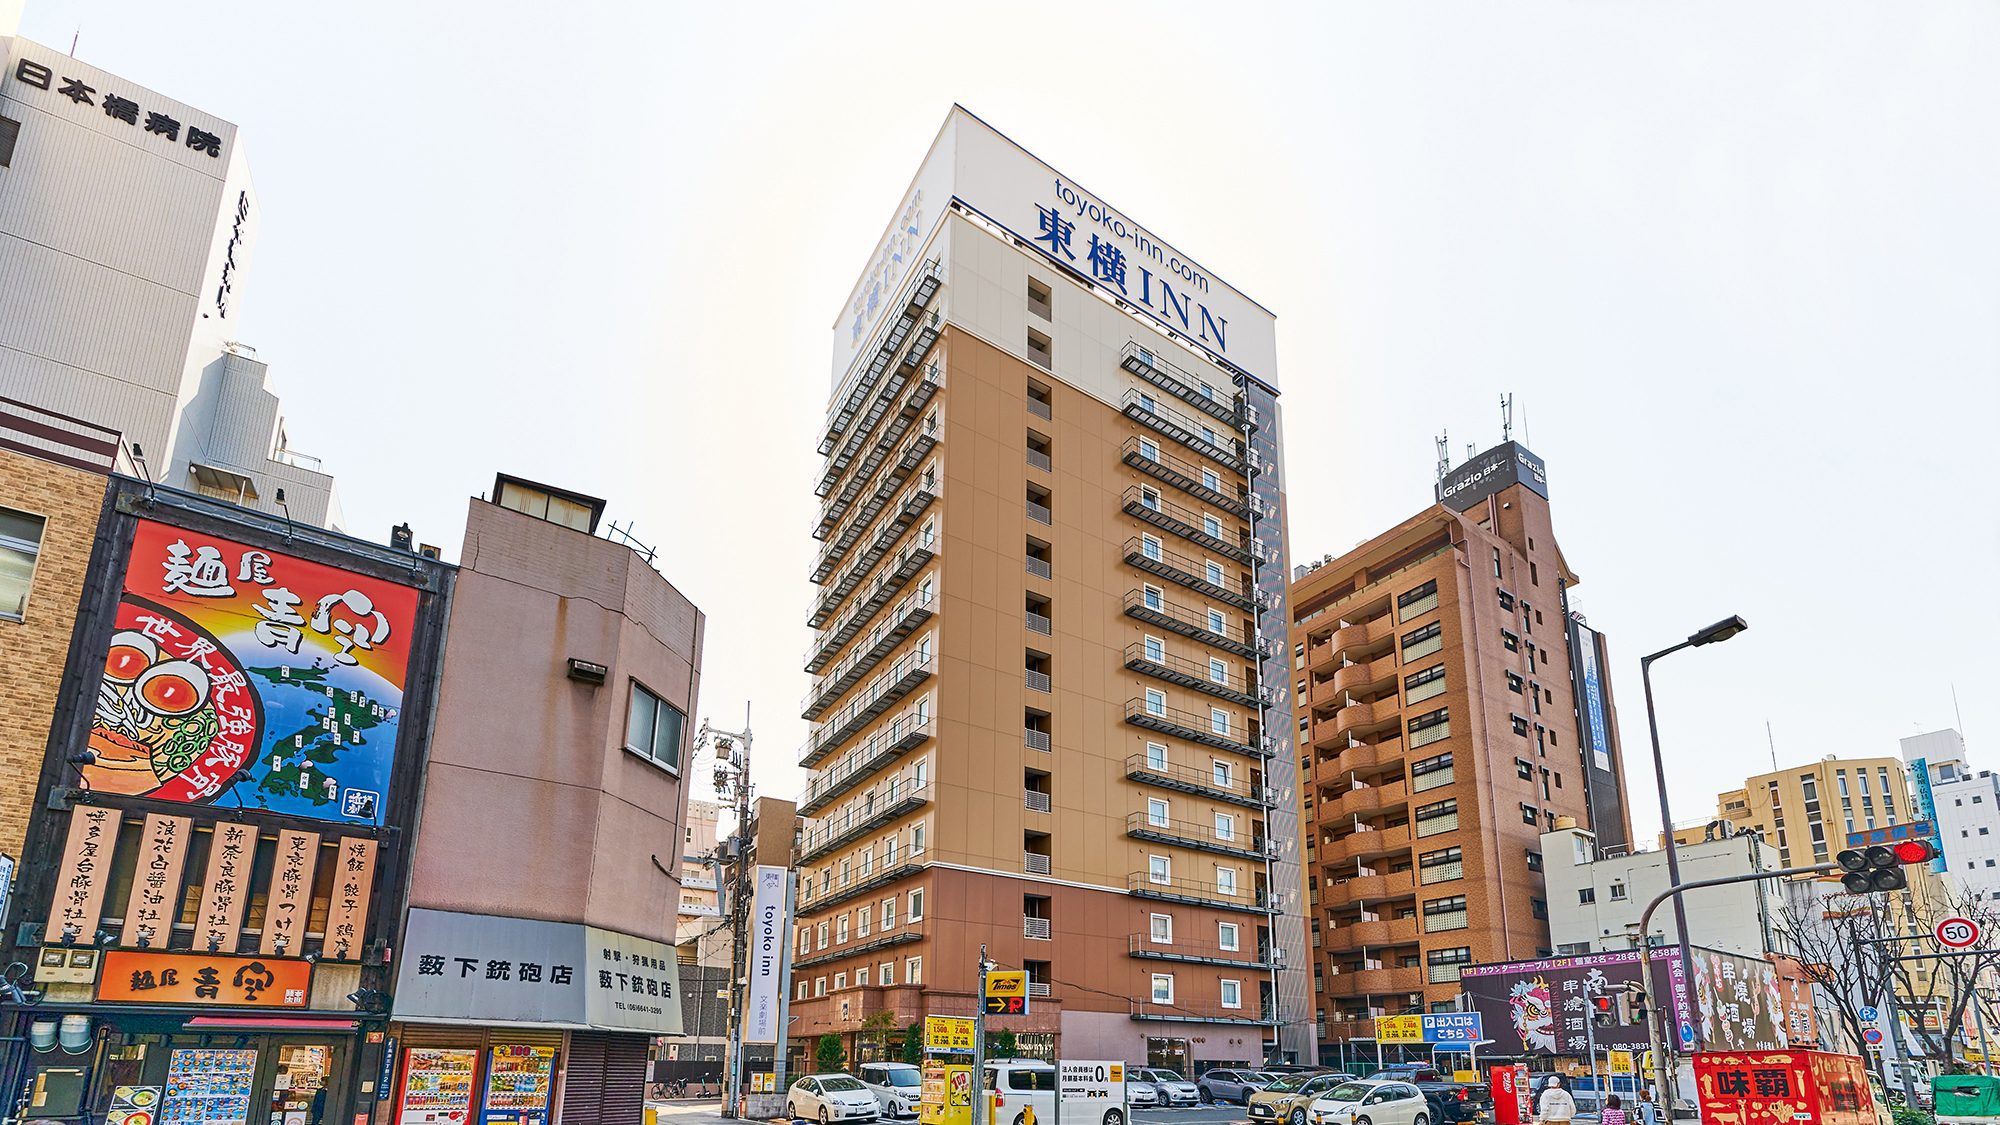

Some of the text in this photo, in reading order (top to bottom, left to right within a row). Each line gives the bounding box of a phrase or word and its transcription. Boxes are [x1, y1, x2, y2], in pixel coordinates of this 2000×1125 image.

[16, 57, 222, 158] 日本橋病院
[1055, 178, 1209, 293] toyoko-inn.com
[1518, 452, 1544, 477] Grazio
[1444, 459, 1506, 498] Grazio 日本一
[761, 905, 776, 976] toyoko inn
[1945, 926, 1969, 940] 50
[603, 948, 666, 971] 射撃・狩猟用品
[992, 978, 1021, 990] Times
[615, 1001, 626, 1010] TEL
[1436, 1016, 1474, 1027] 出入口は
[1437, 1028, 1465, 1039] こちら
[1717, 1069, 1790, 1098] 味覇
